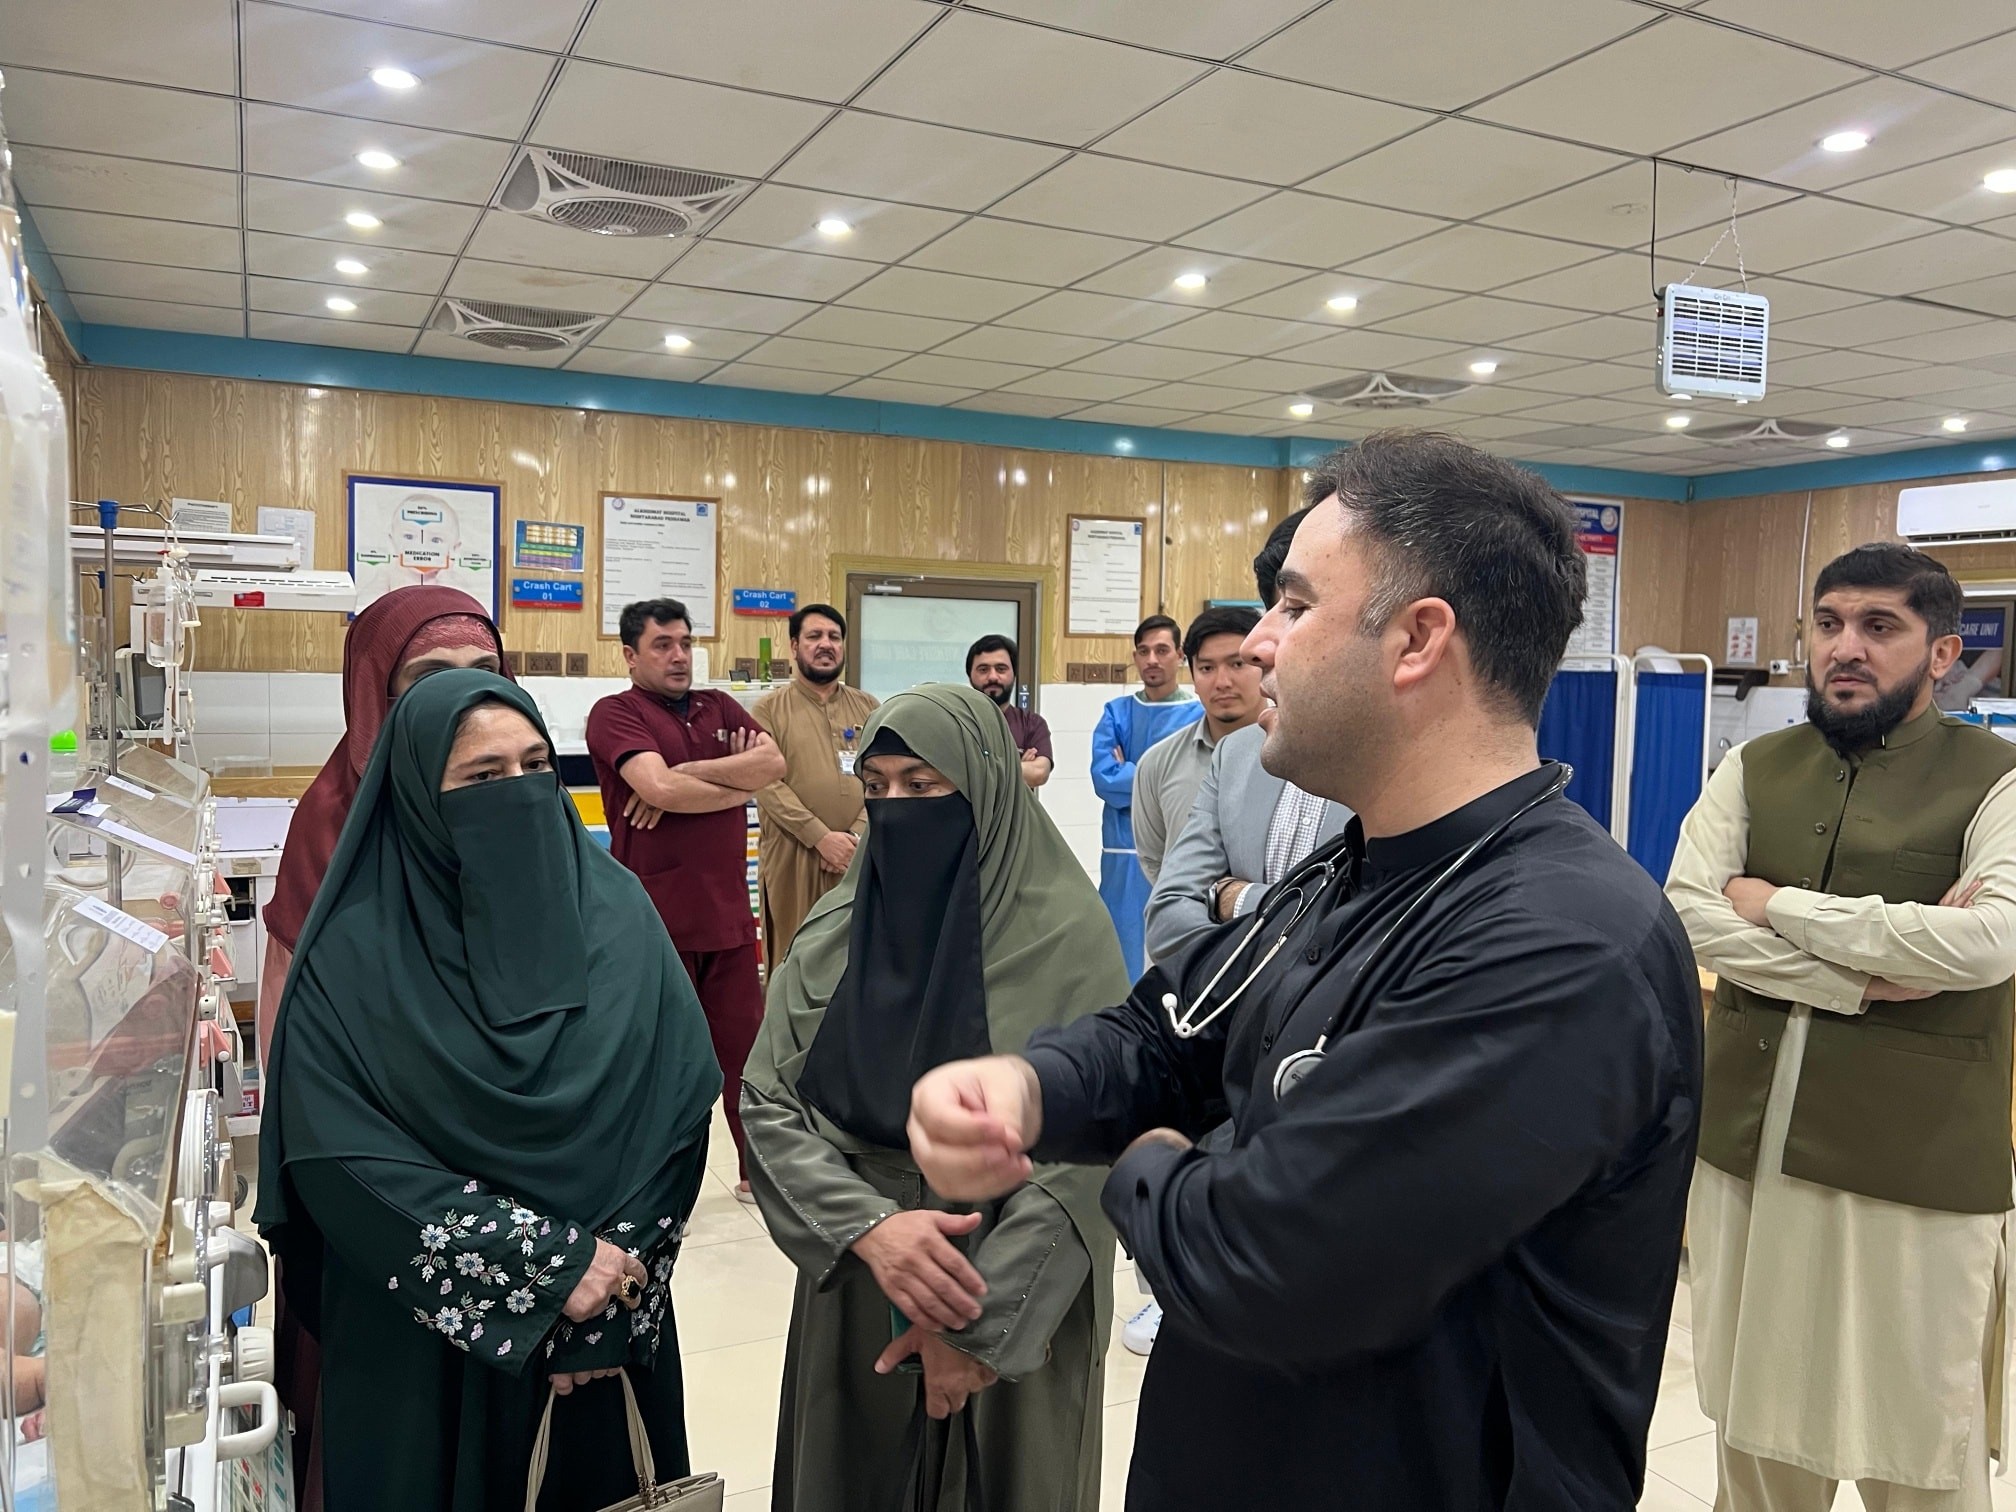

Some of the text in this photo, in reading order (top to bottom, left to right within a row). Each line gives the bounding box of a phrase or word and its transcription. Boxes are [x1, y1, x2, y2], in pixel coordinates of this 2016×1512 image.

[523, 581, 572, 591] Crash Cart
[542, 592, 553, 600] 01
[743, 590, 786, 600] Crash Cart
[759, 600, 770, 608] 02
[1980, 623, 1999, 637] UNIT
